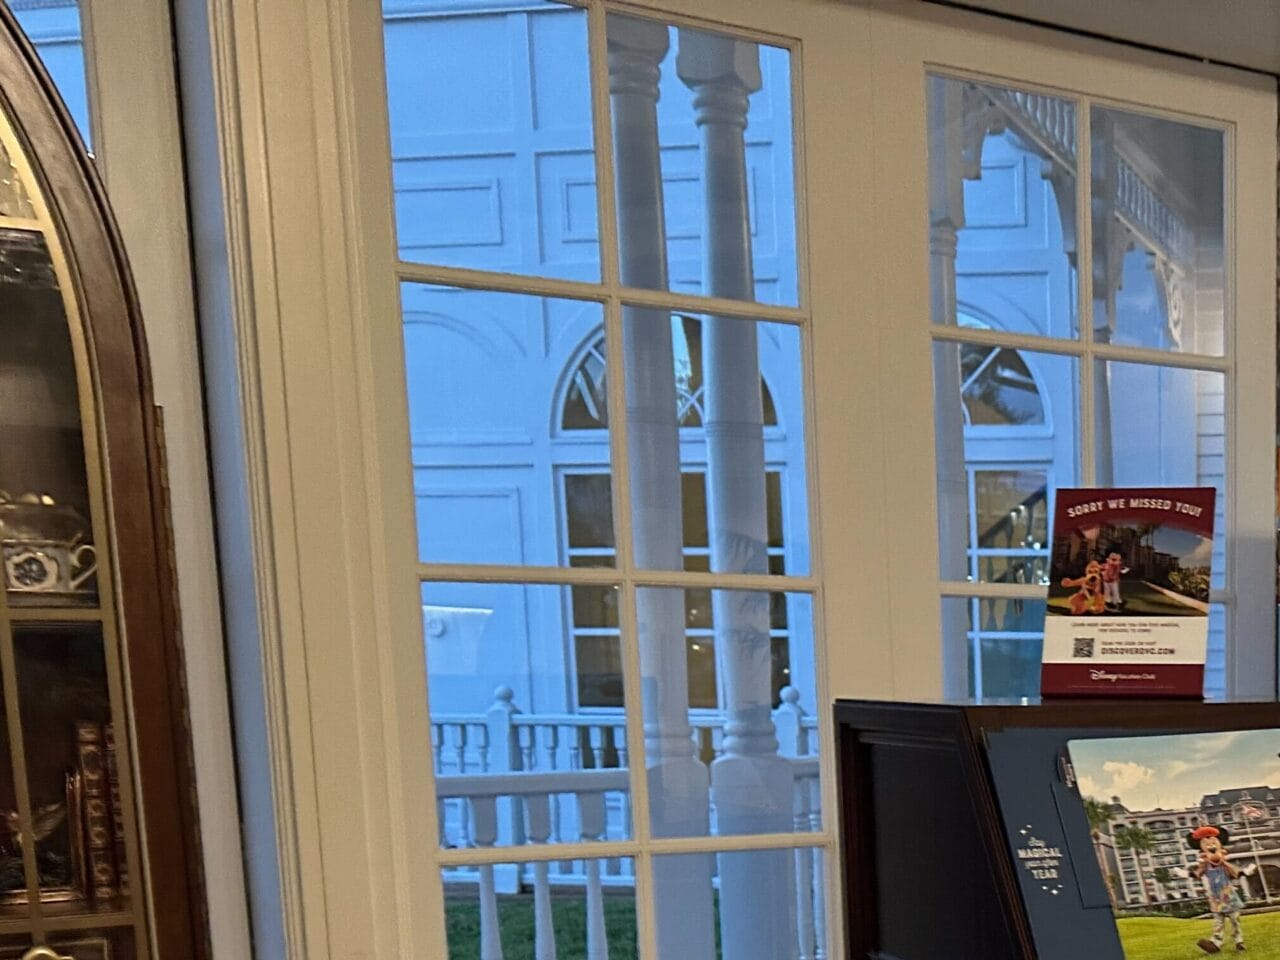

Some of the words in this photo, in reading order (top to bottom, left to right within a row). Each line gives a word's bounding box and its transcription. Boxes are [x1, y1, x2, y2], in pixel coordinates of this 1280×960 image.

[1067, 501, 1104, 518] SORRY
[1107, 498, 1126, 510] WE
[1129, 498, 1172, 511] MISSED
[1176, 501, 1203, 518] YOU!
[1017, 847, 1064, 858] MAGICAL
[1031, 868, 1058, 880] YEAR
